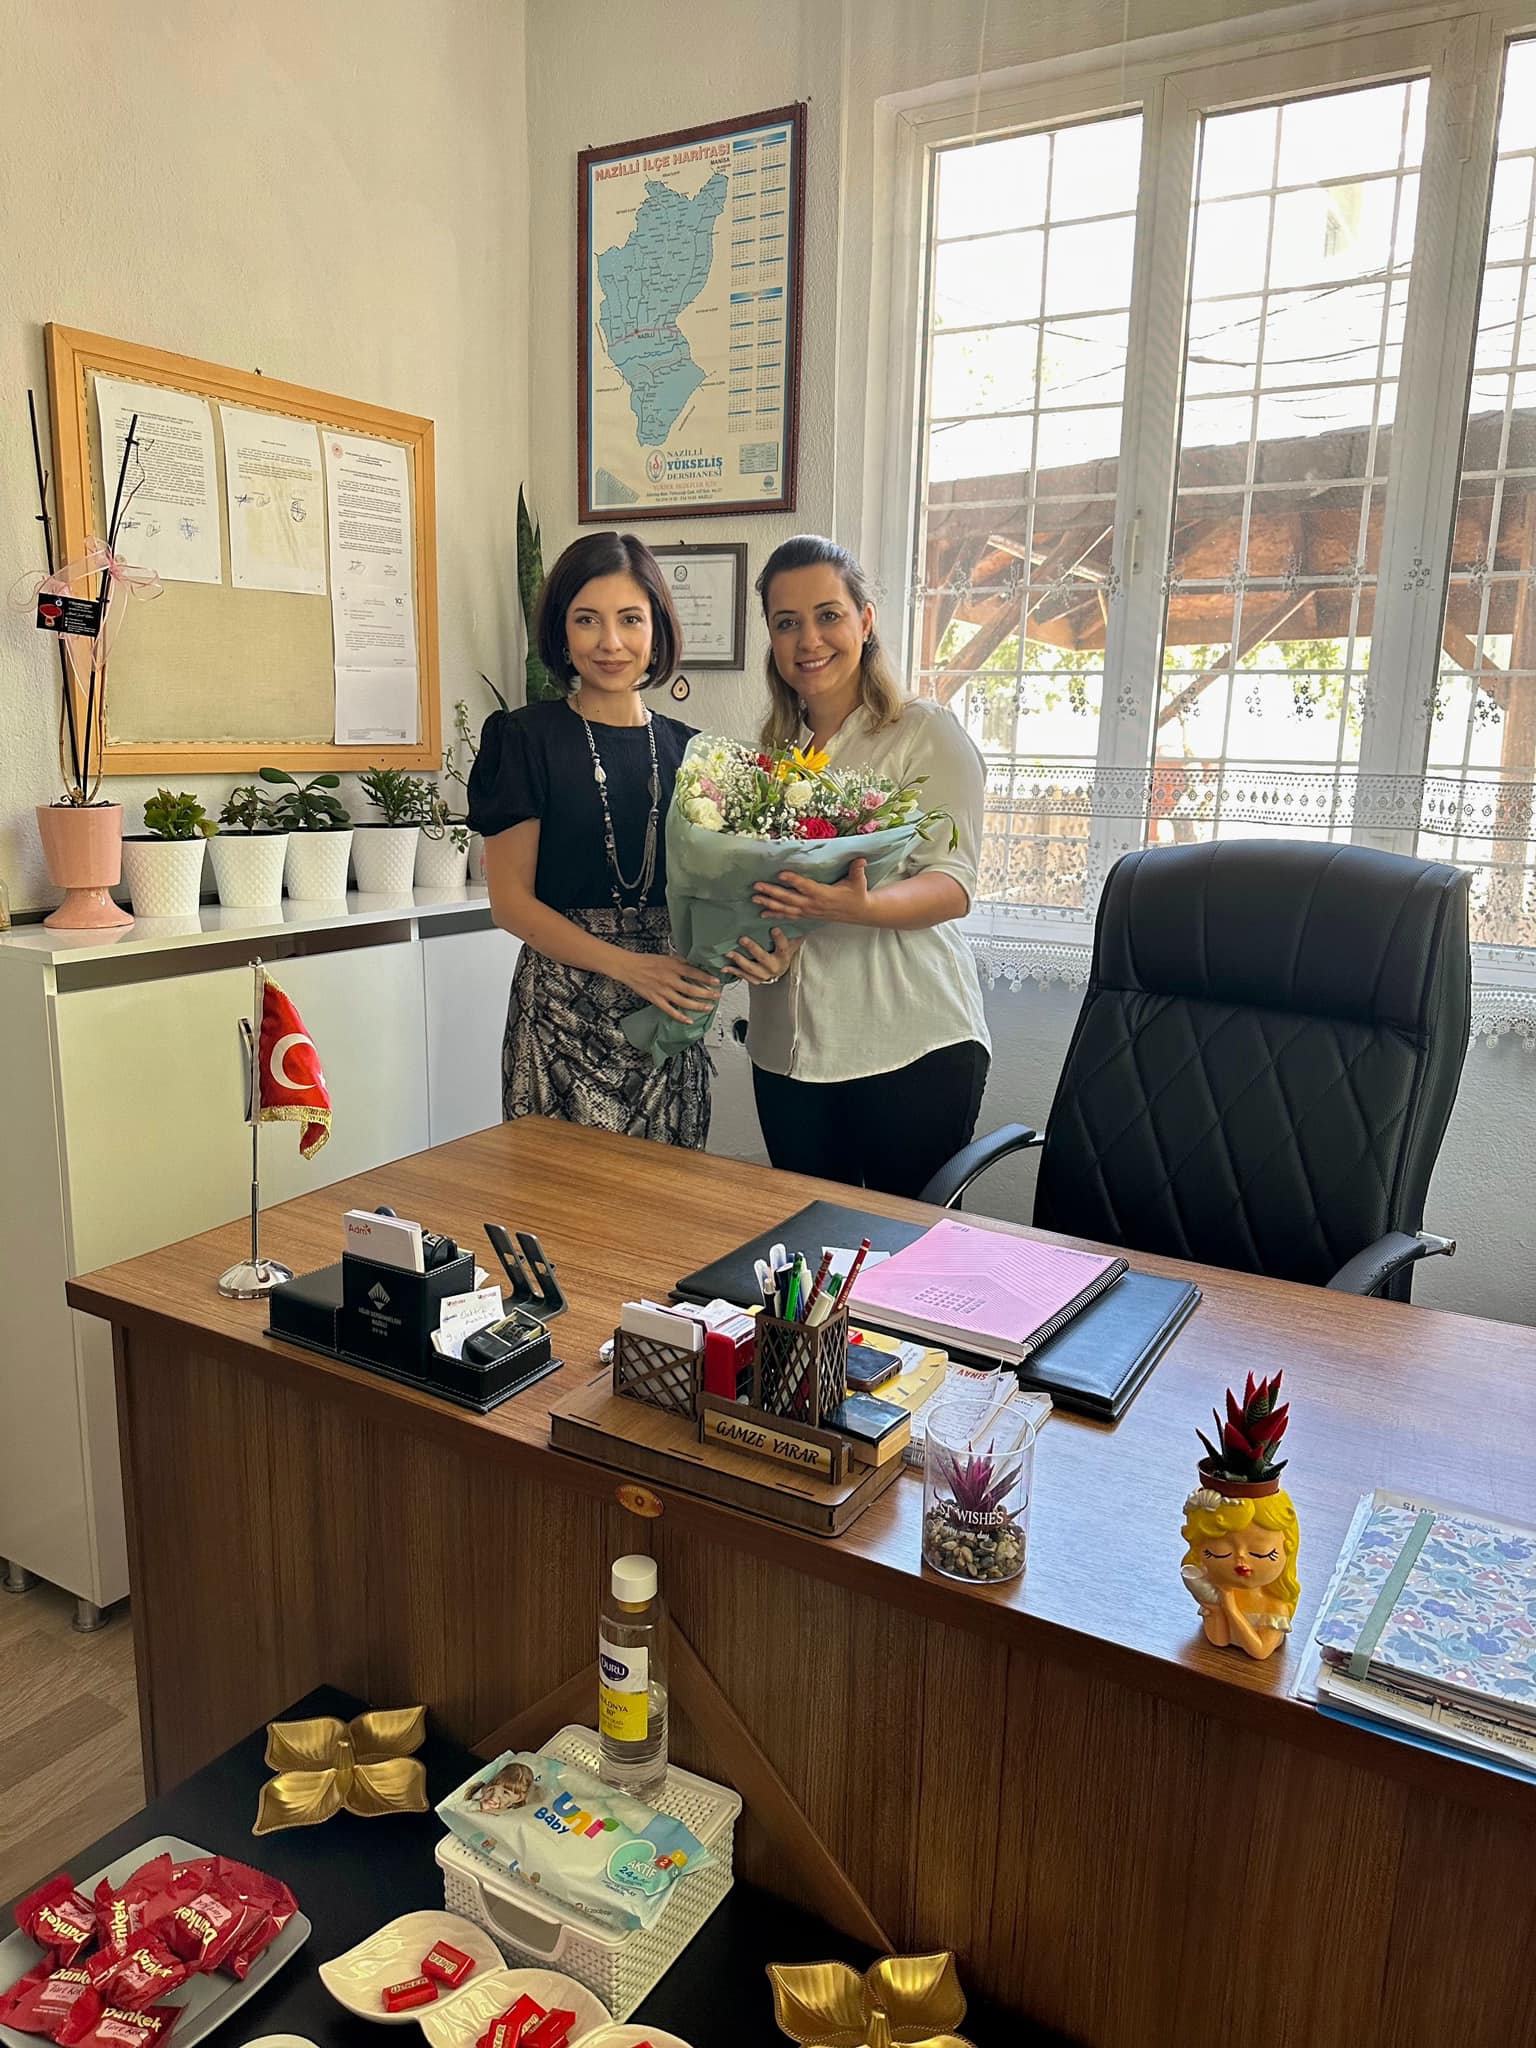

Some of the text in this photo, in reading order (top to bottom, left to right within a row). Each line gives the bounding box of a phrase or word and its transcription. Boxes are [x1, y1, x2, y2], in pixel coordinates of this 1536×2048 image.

[594, 144, 731, 181] NAZİLLİ İLÇE HARİTASI
[667, 448, 703, 458] NAZİLLİ
[667, 455, 723, 471] YÜKSELİŞ
[667, 467, 722, 481] DERSHANESİ
[716, 1421, 820, 1465] GAMZE YARAR
[955, 1507, 1005, 1526] WISHES
[533, 1807, 571, 1835] Baby
[627, 1859, 658, 1880] AKTİF
[39, 1906, 91, 1944] Dankek
[173, 1905, 218, 1945] Dankek
[101, 2007, 162, 2032] Dankek
